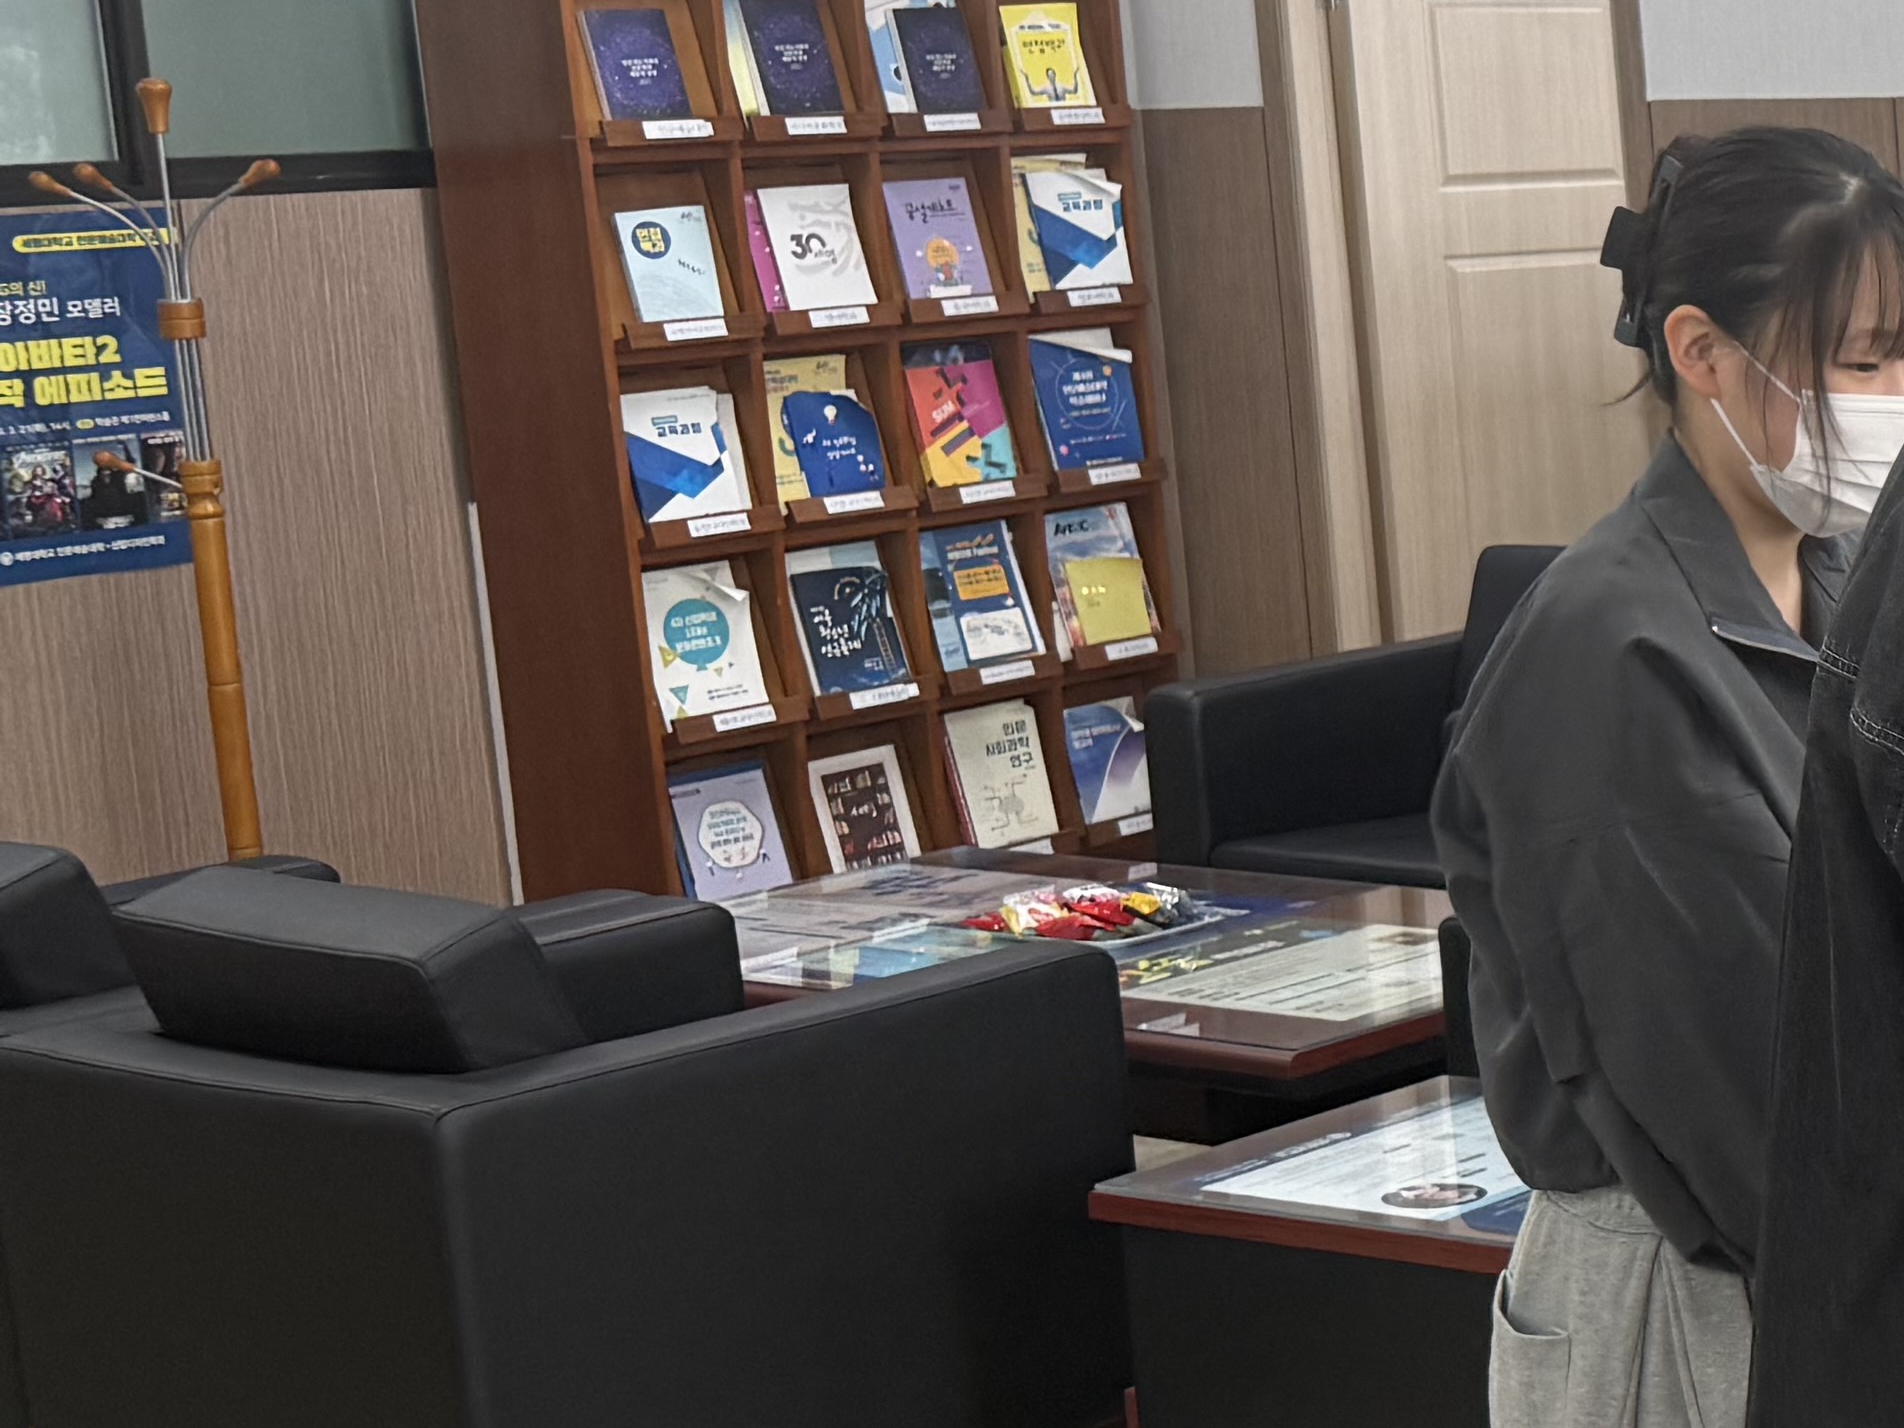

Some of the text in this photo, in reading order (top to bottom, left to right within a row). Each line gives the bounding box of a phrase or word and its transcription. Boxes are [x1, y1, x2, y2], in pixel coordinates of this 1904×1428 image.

[66, 296, 121, 319] 모델러
[0, 335, 122, 372] 아바타2
[33, 367, 168, 406] 에피소드
